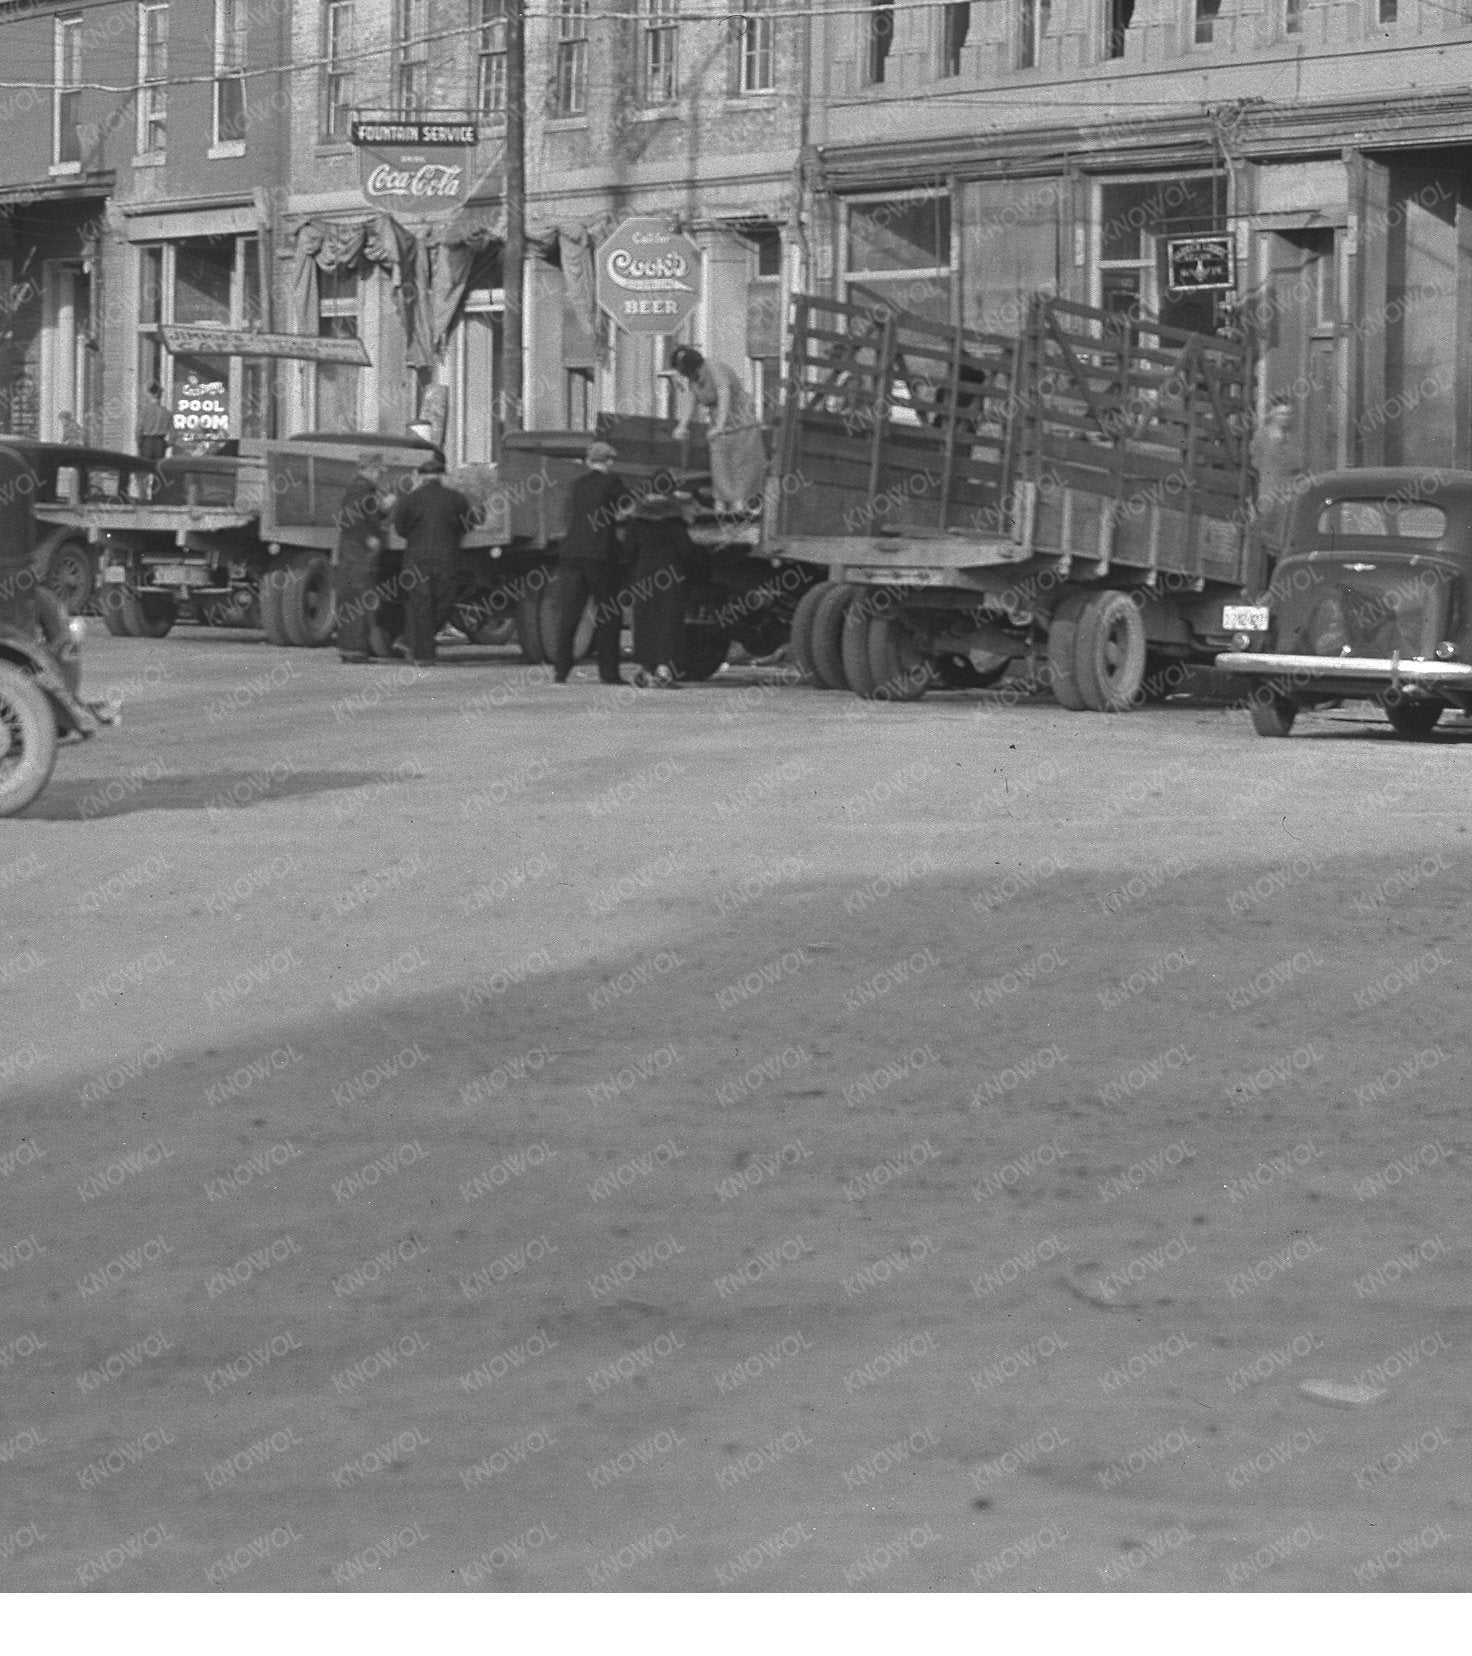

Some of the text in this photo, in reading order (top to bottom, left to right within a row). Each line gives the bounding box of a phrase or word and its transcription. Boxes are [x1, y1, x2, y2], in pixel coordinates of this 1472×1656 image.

[357, 125, 474, 143] FOUNTAIN SERVICE
[624, 300, 679, 314] BEER
[177, 399, 225, 413] POOL
[173, 413, 229, 430] ROOM
